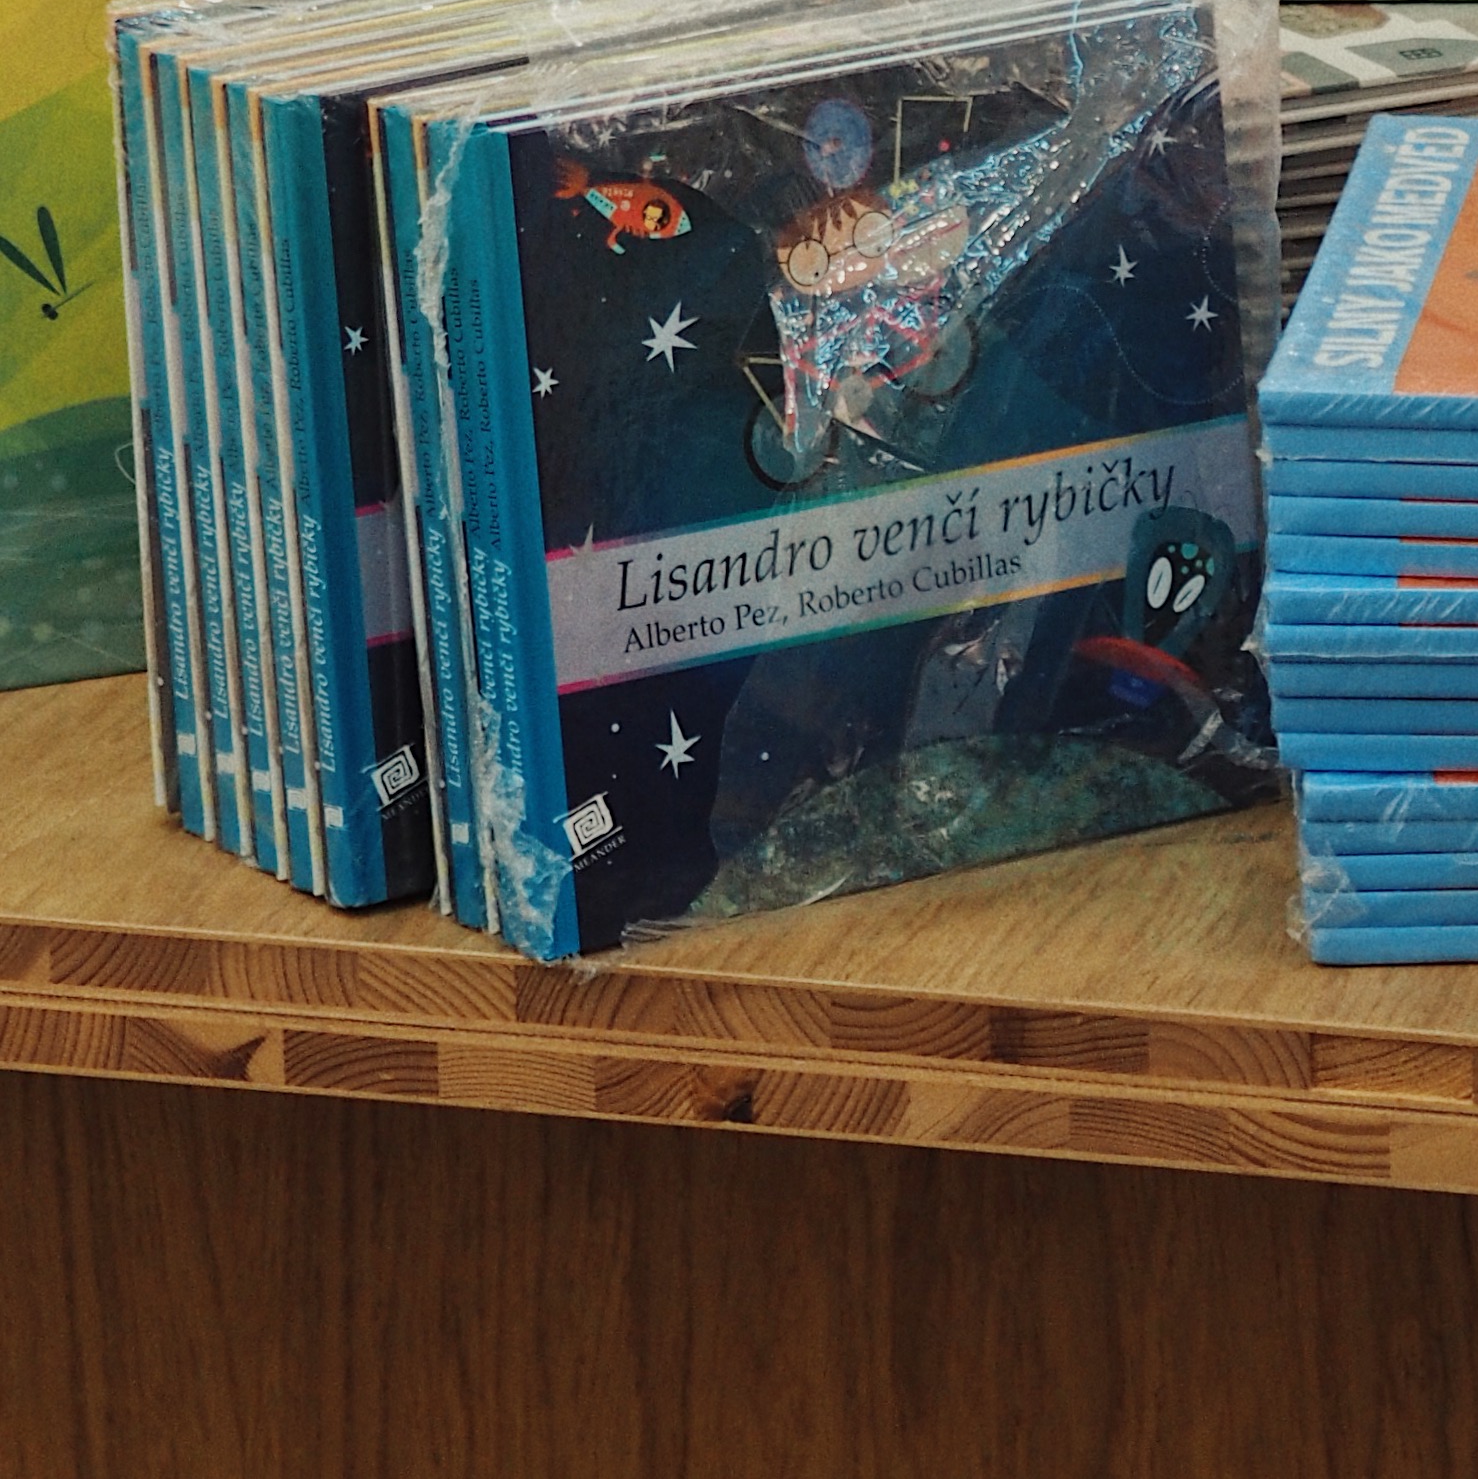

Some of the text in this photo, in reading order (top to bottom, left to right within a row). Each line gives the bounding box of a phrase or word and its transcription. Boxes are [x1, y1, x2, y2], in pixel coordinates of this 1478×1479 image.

[278, 237, 295, 313] Cubillas
[1313, 127, 1471, 368] SILNÝ JAKO MEDVĚD
[447, 266, 465, 342] Cubillas
[286, 319, 302, 391] Roberto
[411, 330, 426, 402] Roberto
[455, 348, 472, 421] Roberto
[417, 409, 432, 445] Pez,
[467, 279, 504, 551] Alberto Pez, Roberto Cubillas
[157, 444, 180, 529] rybičky
[192, 463, 217, 548] rybičky
[228, 480, 252, 564] rybičky
[423, 451, 437, 518] Alberto
[467, 471, 482, 539] Alberto
[263, 497, 289, 581] rybičky
[299, 513, 328, 599] rybičky
[424, 526, 452, 613] rybičky
[617, 459, 1177, 613] Lisandro venčí rybičky
[470, 545, 495, 632] rybičky
[491, 558, 519, 644] rybičky
[623, 550, 1023, 654] Alberto Pez, Roberto Cubillas
[171, 602, 189, 700] Lisandro
[208, 620, 229, 719] Lisandro
[243, 638, 264, 737] Lisandro
[279, 655, 300, 754] Lisandro
[315, 673, 336, 772] Lisandro
[442, 688, 462, 788] Lisandro
[573, 832, 628, 872] MEANDER
